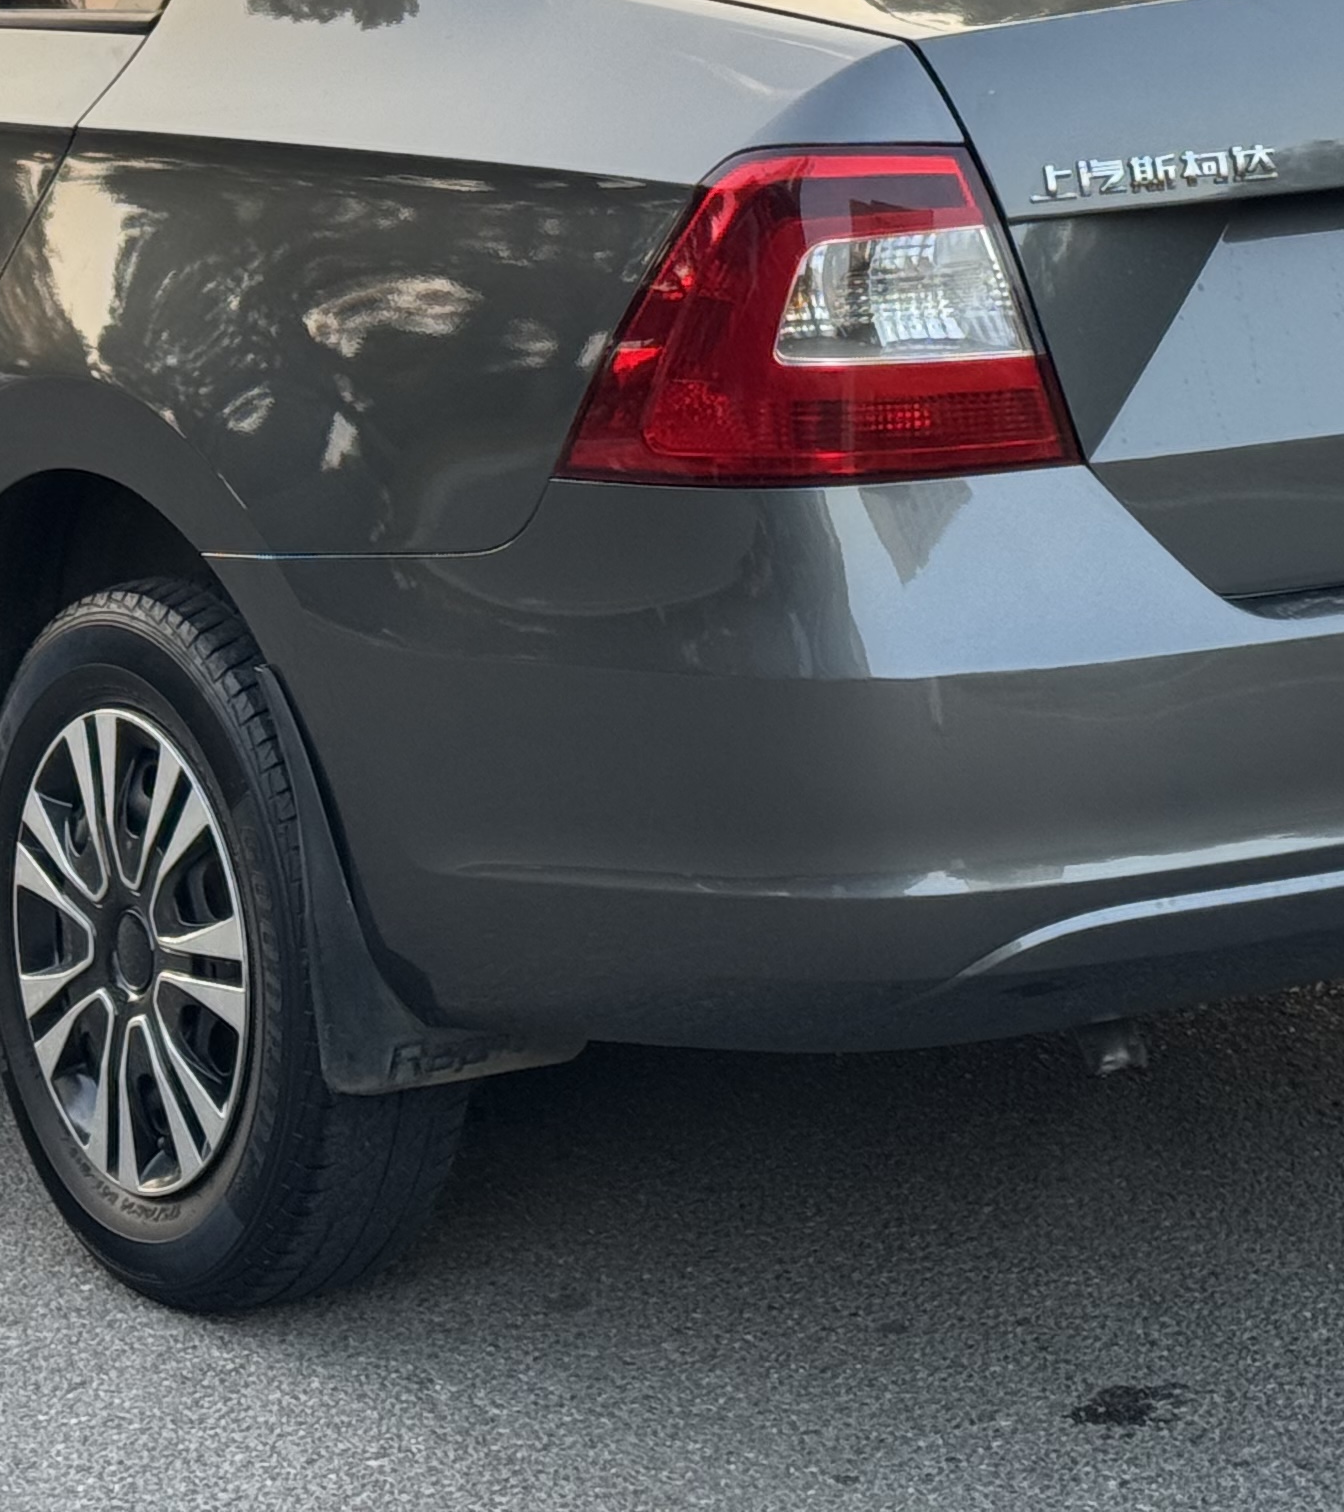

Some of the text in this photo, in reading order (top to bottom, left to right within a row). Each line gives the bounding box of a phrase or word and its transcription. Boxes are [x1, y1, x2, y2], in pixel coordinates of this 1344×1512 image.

[1029, 144, 1279, 204] 上汽斯柯达
